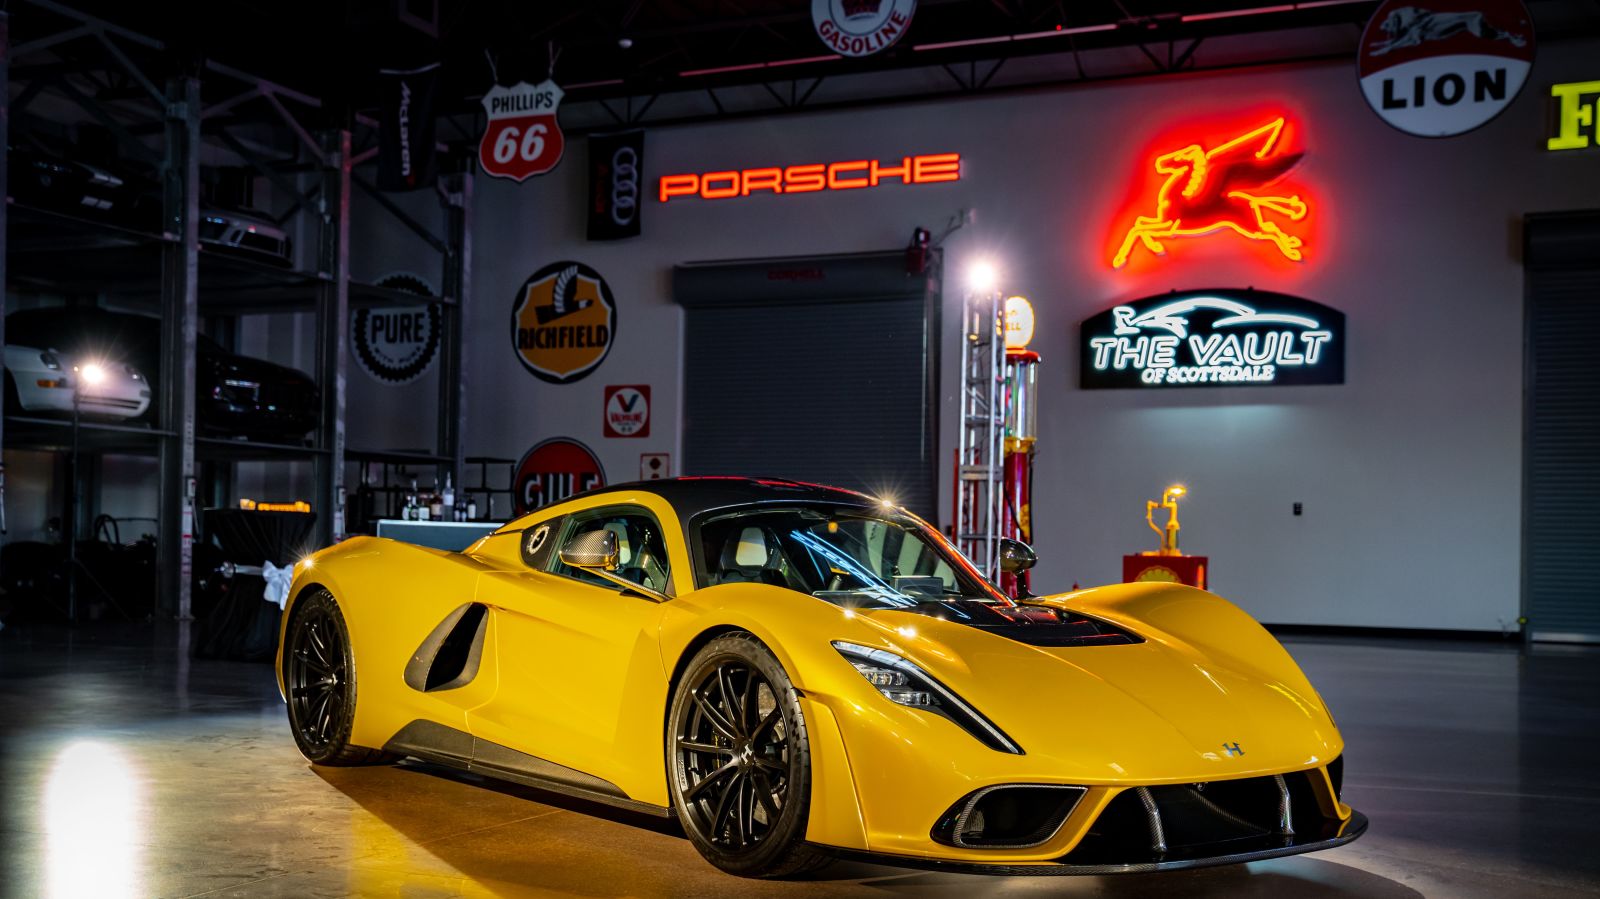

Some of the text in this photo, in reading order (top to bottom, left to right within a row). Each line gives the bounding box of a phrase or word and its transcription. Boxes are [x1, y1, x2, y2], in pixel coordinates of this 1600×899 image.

[819, 10, 906, 54] GASOLINE
[491, 91, 553, 114] PHILLIPS
[1382, 68, 1506, 110] LION
[1547, 81, 1600, 151] F
[493, 123, 548, 164] 66
[659, 153, 961, 203] PORSCHE
[371, 312, 425, 344] PURE
[517, 324, 609, 350] RICHFIELD
[1091, 331, 1332, 369] THE VAULT
[1142, 365, 1275, 383] OF SCOTTSDALE
